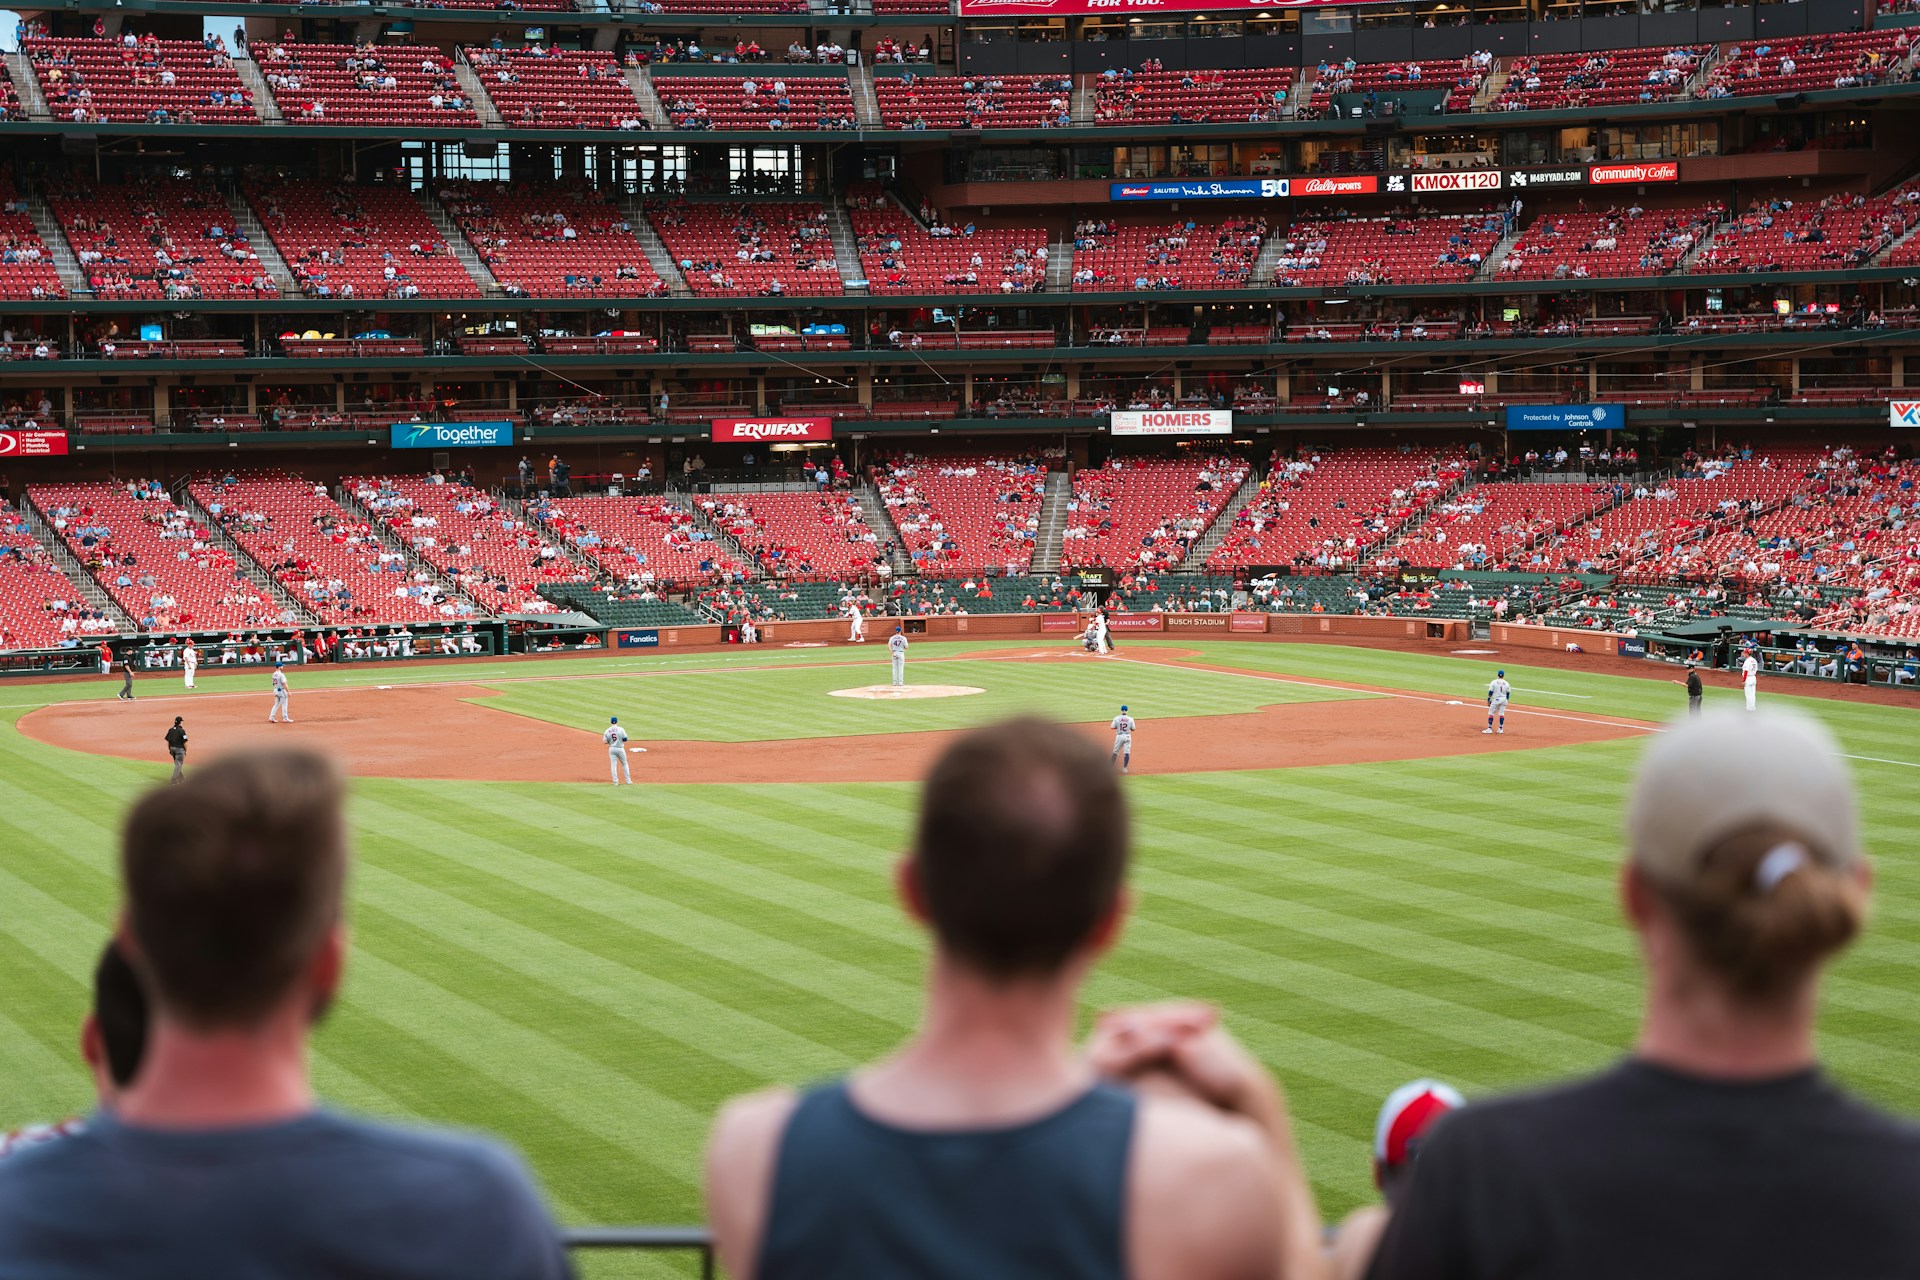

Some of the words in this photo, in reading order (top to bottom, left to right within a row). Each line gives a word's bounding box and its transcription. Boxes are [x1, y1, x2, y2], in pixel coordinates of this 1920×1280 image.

[1530, 171, 1581, 183] M4BYYADI.COM
[1592, 166, 1646, 183] Community
[1647, 166, 1675, 179] Coffee
[1261, 179, 1290, 198] 50
[1305, 179, 1337, 194] Bally
[1338, 182, 1362, 191] SPORTS
[1142, 413, 1211, 427] HOMERS
[1564, 413, 1589, 421] Johnson
[433, 426, 499, 444] Together
[732, 423, 810, 440] EQUIFAX
[1194, 618, 1225, 626] STADIUM
[629, 635, 658, 643] Fanatics
[1625, 644, 1645, 653] Fanatics
[1119, 723, 1128, 732] 12
